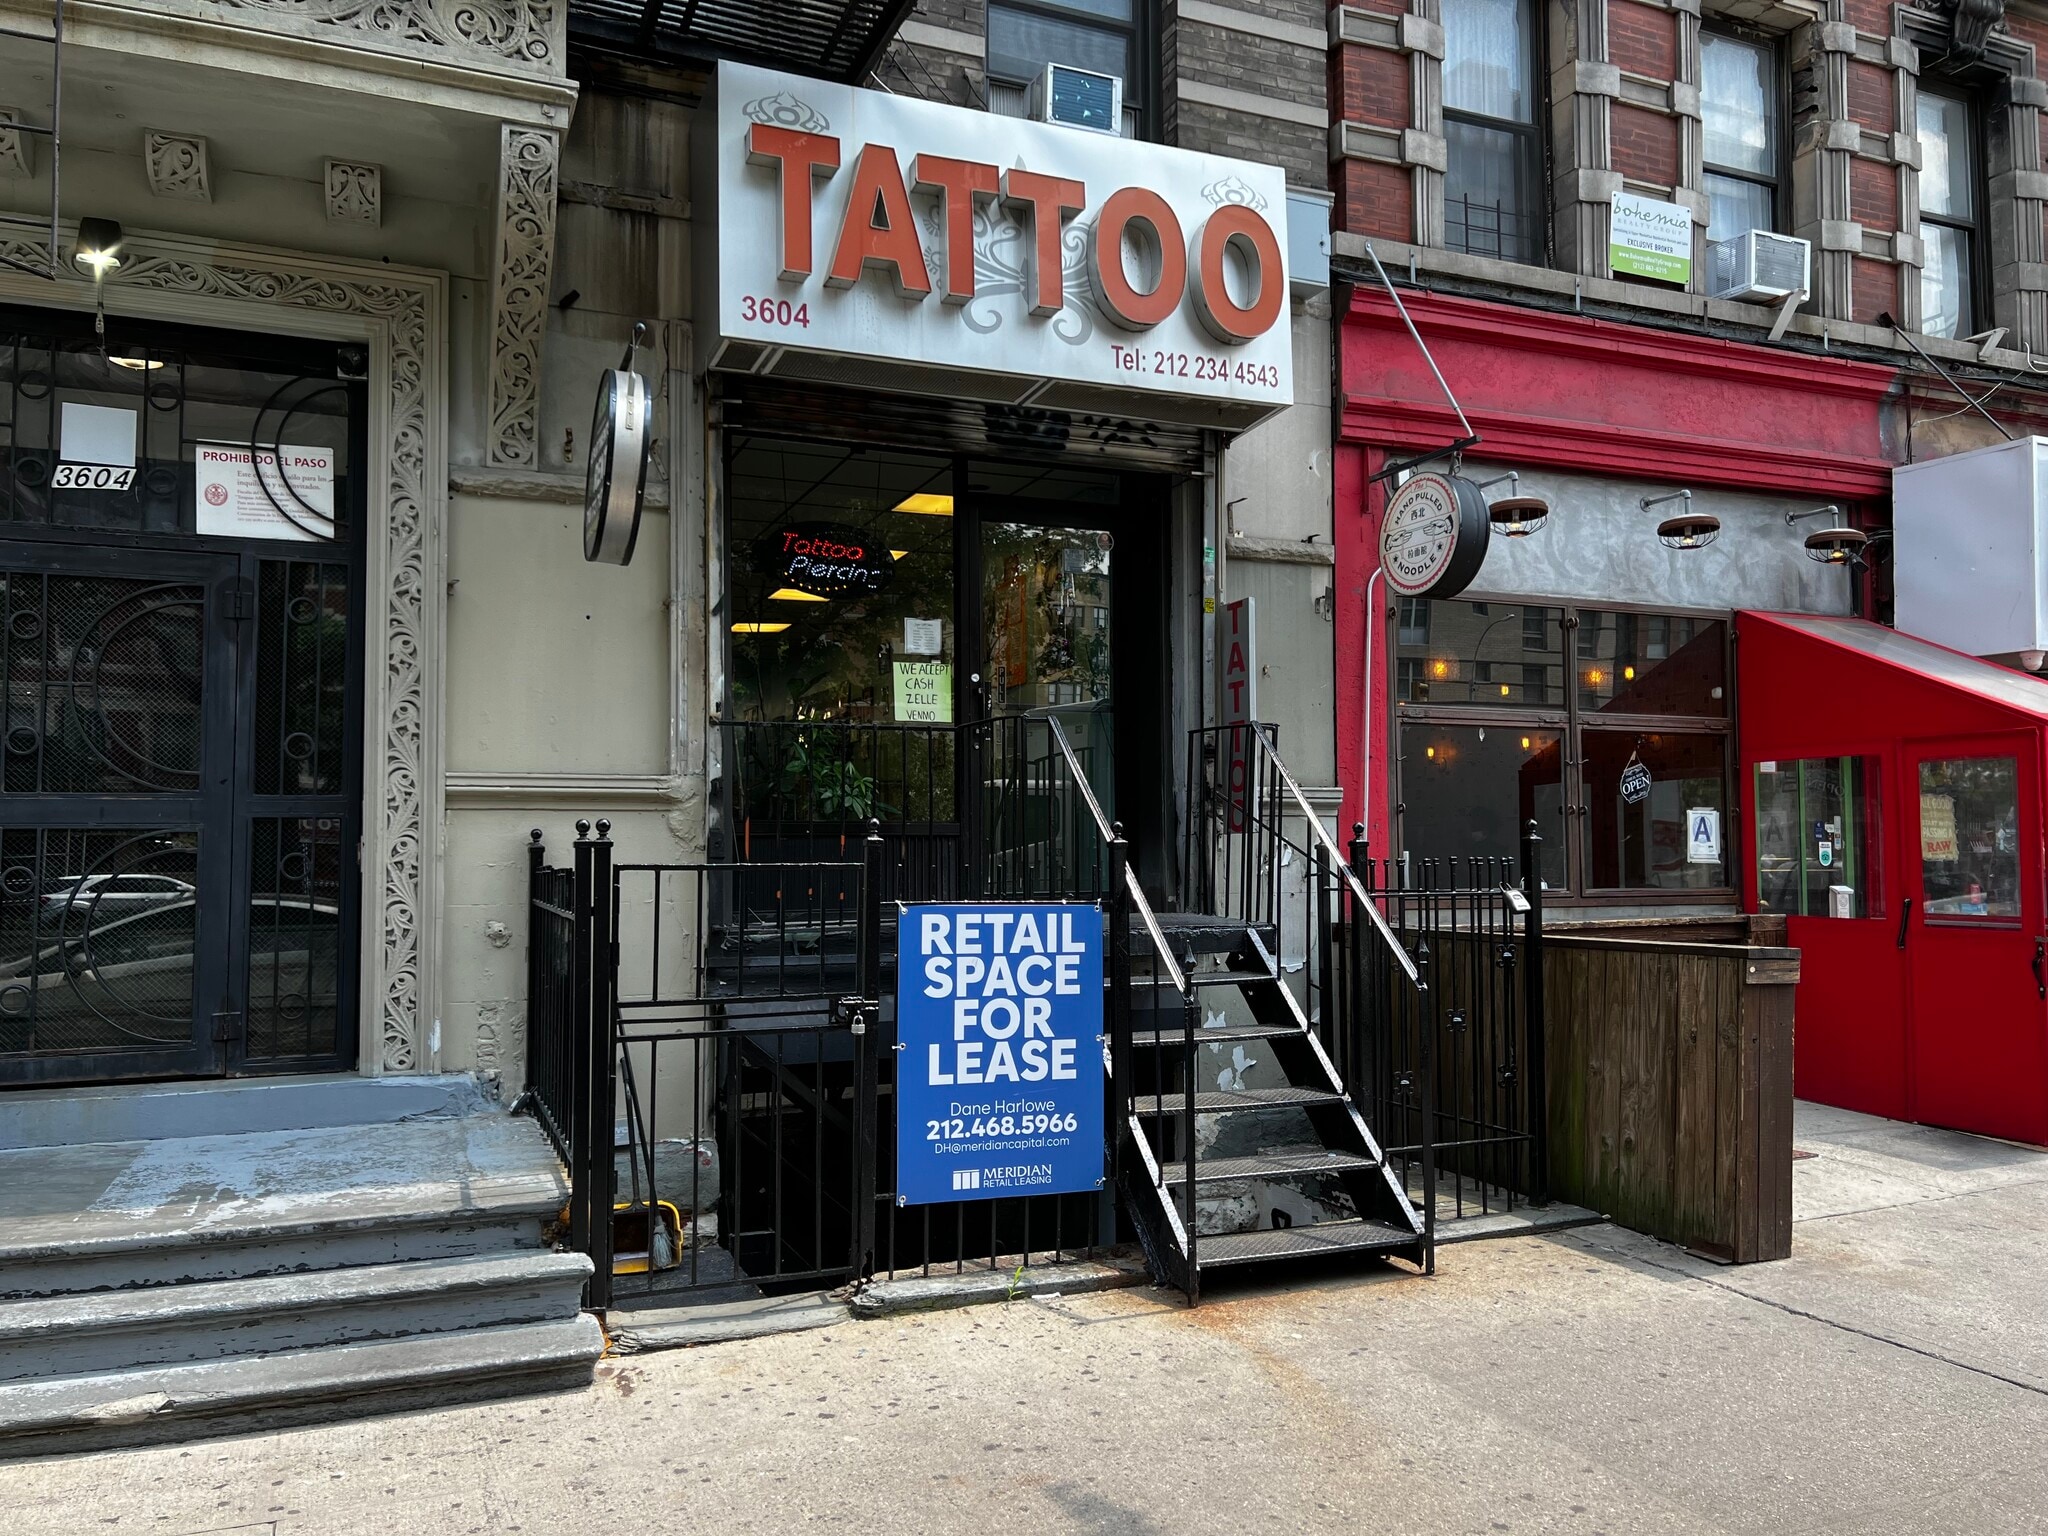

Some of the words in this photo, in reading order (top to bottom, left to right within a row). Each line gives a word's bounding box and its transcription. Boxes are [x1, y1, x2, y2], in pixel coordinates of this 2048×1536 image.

[1613, 198, 1688, 229] bohemia
[745, 122, 1284, 345] TATTOO
[1617, 217, 1650, 229] REALTY
[1654, 226, 1683, 236] GROUP
[1627, 238, 1653, 251] EXCLUSIVE
[1654, 243, 1674, 254] BROKER
[742, 296, 810, 328] 3604
[1111, 345, 1147, 372] Tel:
[1154, 351, 1188, 377] 212
[1195, 356, 1229, 382] 234
[1235, 361, 1279, 388] 4543
[279, 456, 291, 466] EL
[294, 457, 327, 468] PASO
[56, 466, 132, 489] 3604
[237, 470, 252, 478] Este
[302, 476, 317, 484] para
[1394, 496, 1415, 525] HAND
[1415, 492, 1443, 512] PULLED
[1411, 507, 1426, 521] 西北
[783, 532, 864, 560] Tattoo
[1397, 552, 1438, 576] NOODLE
[900, 664, 917, 675] WE
[919, 664, 949, 676] ACCEPT
[905, 678, 934, 690] CASH
[906, 694, 938, 705] ZELLE
[1226, 600, 1246, 833] TATTOO
[1622, 775, 1650, 795] OPEN
[1693, 816, 1711, 842] A
[1922, 827, 1948, 839] PASSING
[1927, 840, 1952, 853] RAW
[921, 913, 1086, 955] RETAIL
[923, 954, 1081, 998] SPACE
[953, 998, 1055, 1041] FOR
[928, 1038, 1077, 1086] LEASE
[951, 1102, 991, 1117] Dane
[994, 1098, 1056, 1114] Harlowe
[926, 1112, 1078, 1141] 212.468.5966
[934, 1136, 1070, 1154] DH@meridiancapital.com
[983, 1163, 1052, 1179] MERIDIAN
[983, 1177, 1012, 1188] RETAIL
[1014, 1174, 1052, 1186] LEASING
